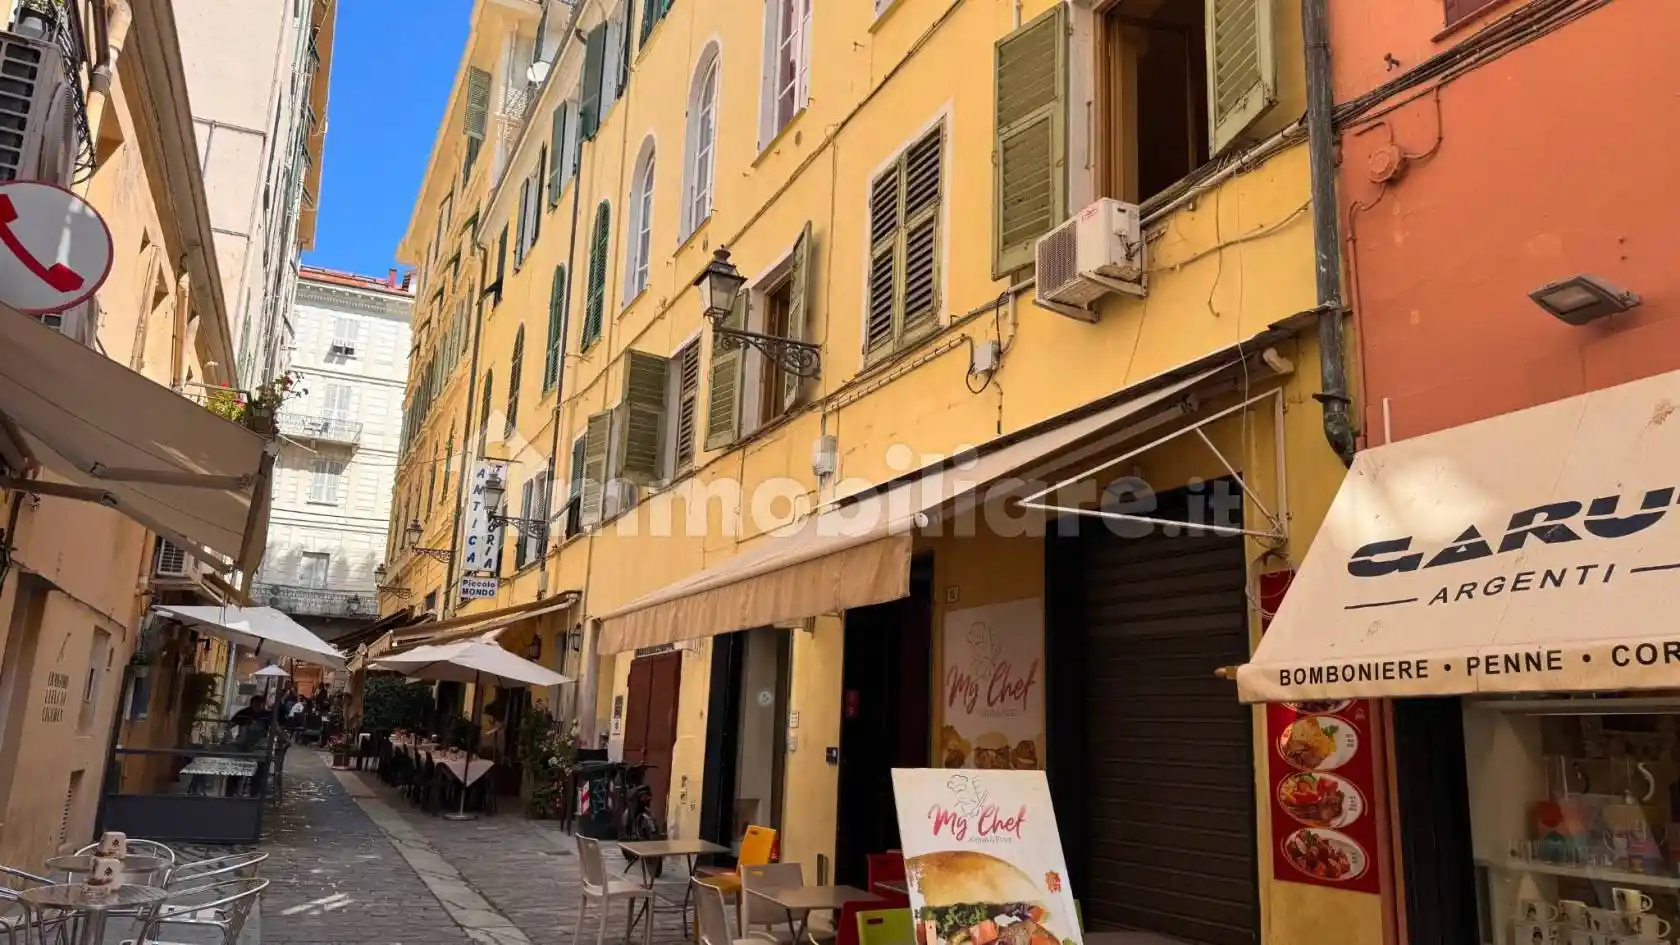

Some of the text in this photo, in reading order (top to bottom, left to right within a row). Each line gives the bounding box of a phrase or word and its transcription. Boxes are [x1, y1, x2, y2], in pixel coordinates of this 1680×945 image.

[461, 587, 495, 597] MONDO
[462, 579, 496, 588] Piccolo
[1428, 563, 1616, 606] ARGENTI
[946, 657, 1040, 715] My Chef
[1279, 659, 1429, 686] BOMBONIERE
[1466, 650, 1563, 676] PENNE
[927, 803, 1027, 842] My Chef
